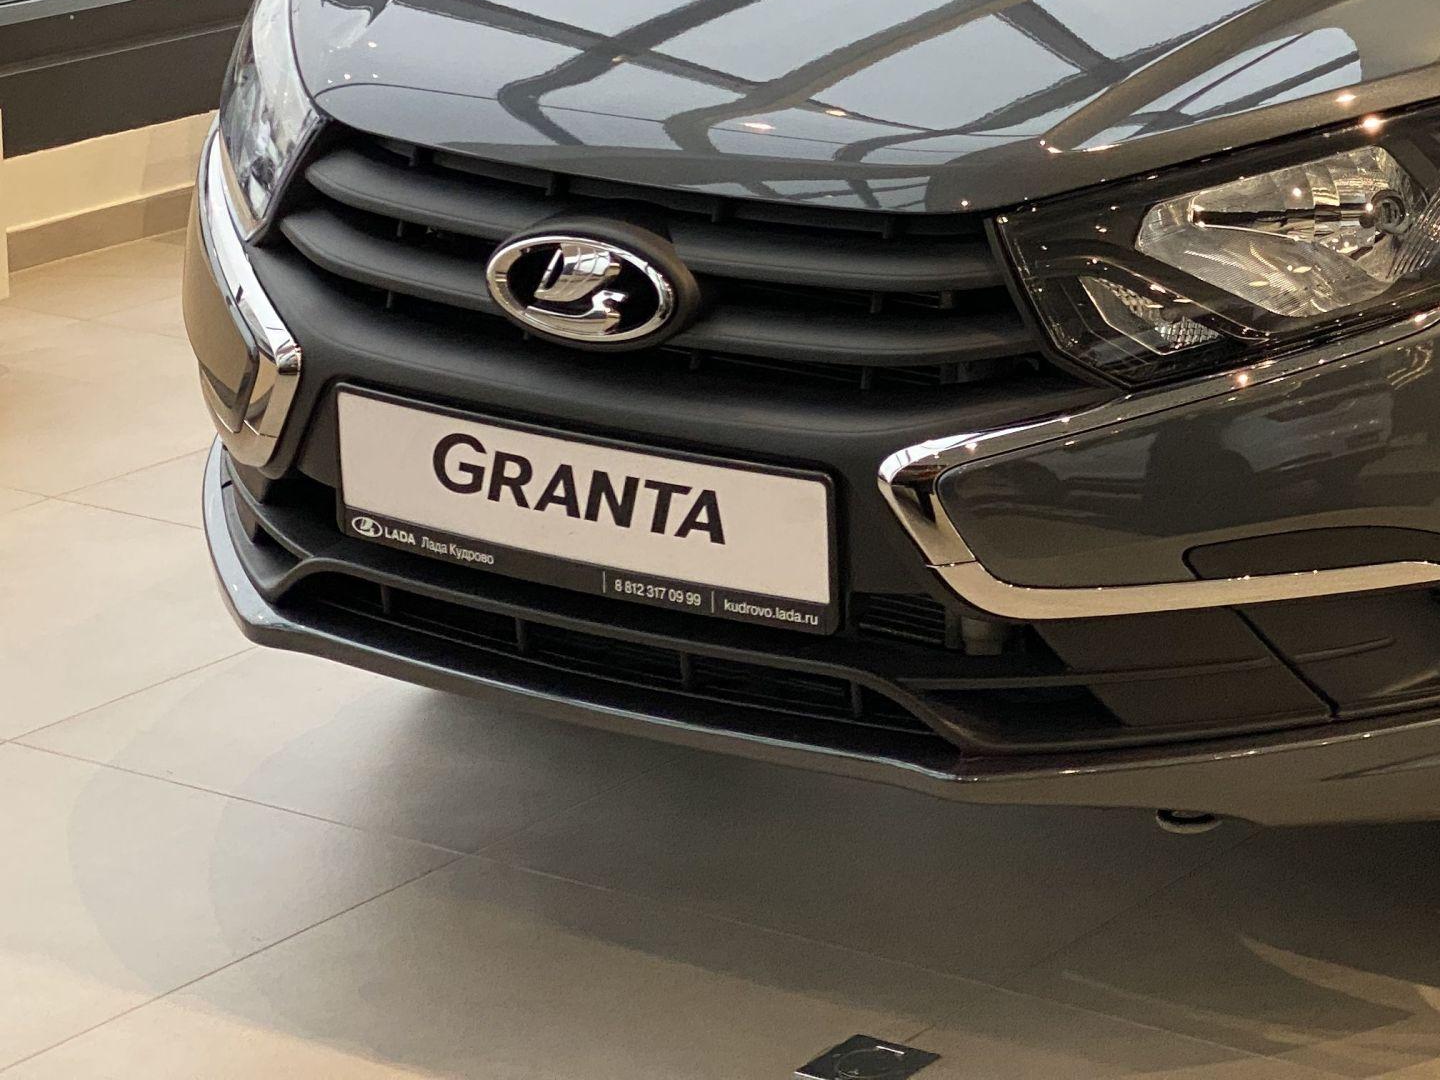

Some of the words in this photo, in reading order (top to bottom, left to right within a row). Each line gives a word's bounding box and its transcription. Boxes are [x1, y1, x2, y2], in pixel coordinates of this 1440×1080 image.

[431, 432, 727, 545] GRANTA
[384, 526, 416, 546] LADA
[421, 536, 448, 554] Лада
[449, 543, 495, 565] Кудрово
[614, 579, 622, 592] 8
[624, 580, 645, 597] 812
[646, 585, 666, 600] 317
[668, 589, 684, 603] 09
[686, 592, 702, 607] 99
[724, 599, 819, 626] kudrovo.lada.ru
